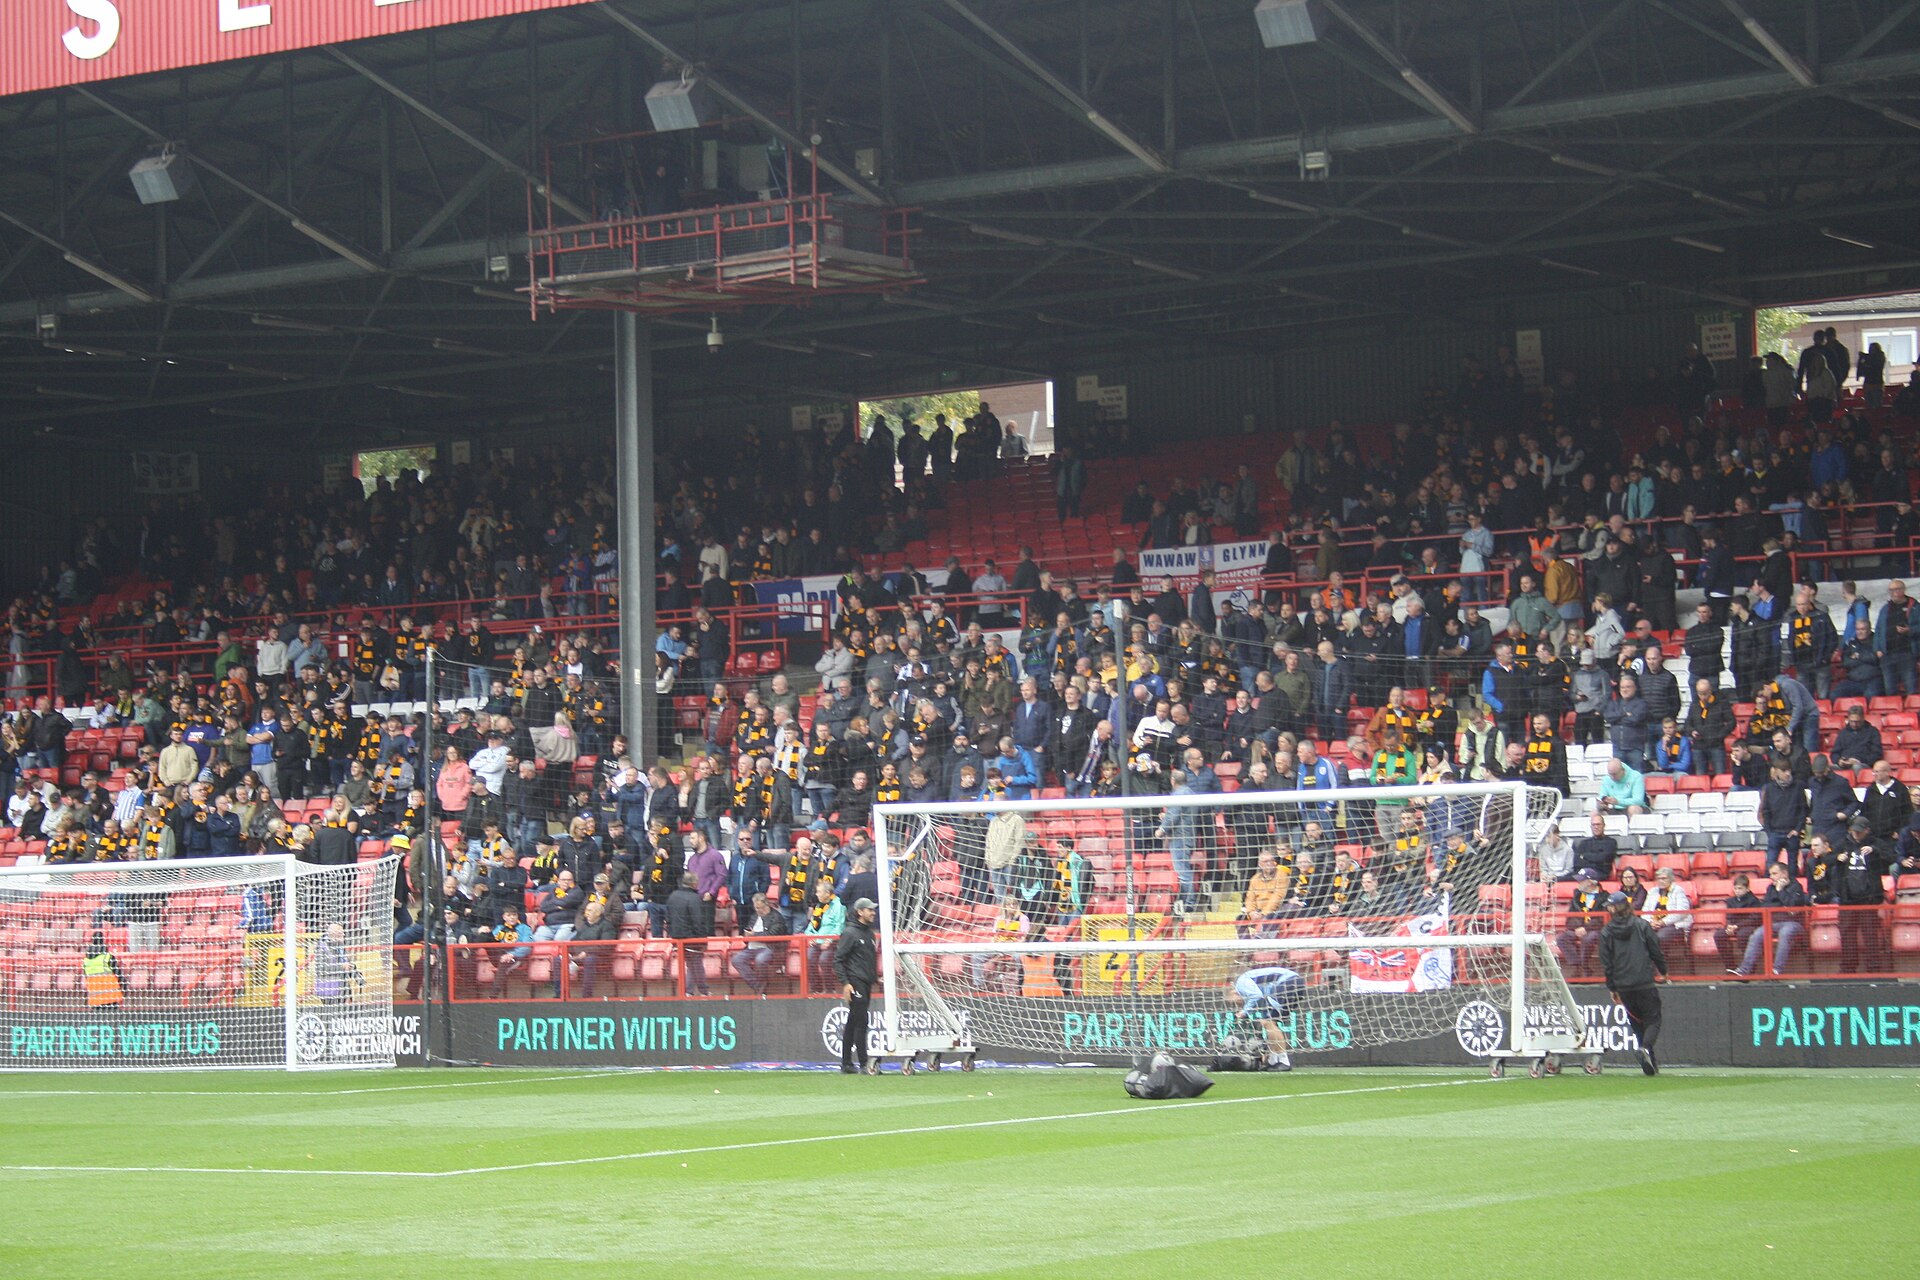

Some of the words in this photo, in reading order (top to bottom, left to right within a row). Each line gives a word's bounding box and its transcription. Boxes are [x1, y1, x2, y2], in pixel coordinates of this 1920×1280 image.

[1143, 552, 1196, 568] WAWAW
[1222, 542, 1266, 562] GLYNN
[331, 1016, 403, 1035] UNIVERSITY
[403, 1016, 421, 1034] OF
[1064, 1012, 1207, 1048] PARNER
[1306, 1010, 1353, 1049] US
[1613, 1004, 1631, 1025] O
[1751, 1006, 1920, 1046] PARTNER
[11, 1025, 114, 1056] PARTNER
[120, 1023, 180, 1055] WITH
[186, 1021, 220, 1055] US
[332, 1033, 421, 1055] GREENWICH
[498, 1017, 616, 1051] PARTNER
[622, 1016, 692, 1051] WITH
[698, 1015, 737, 1051] US
